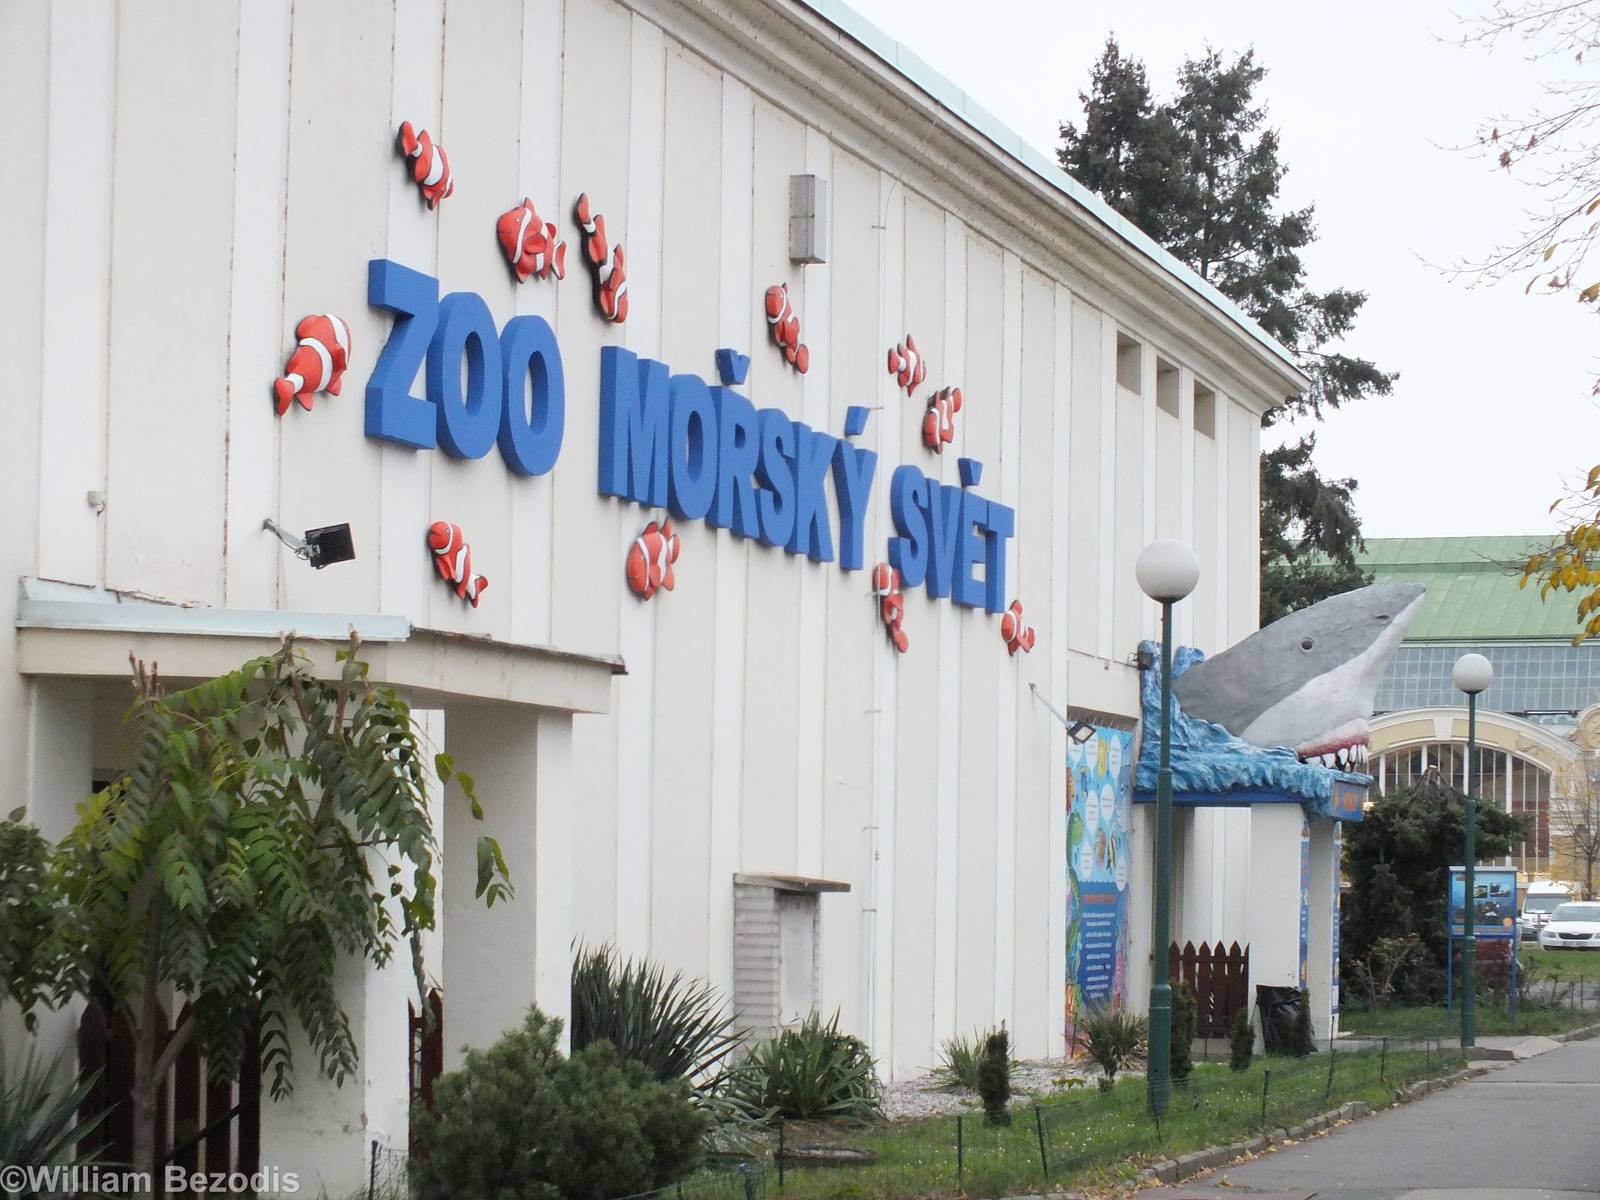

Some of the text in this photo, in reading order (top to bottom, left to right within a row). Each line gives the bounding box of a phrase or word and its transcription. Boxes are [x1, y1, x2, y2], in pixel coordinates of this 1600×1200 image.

[365, 258, 1015, 615] ZOO MOŘSKÝ SVĚT
